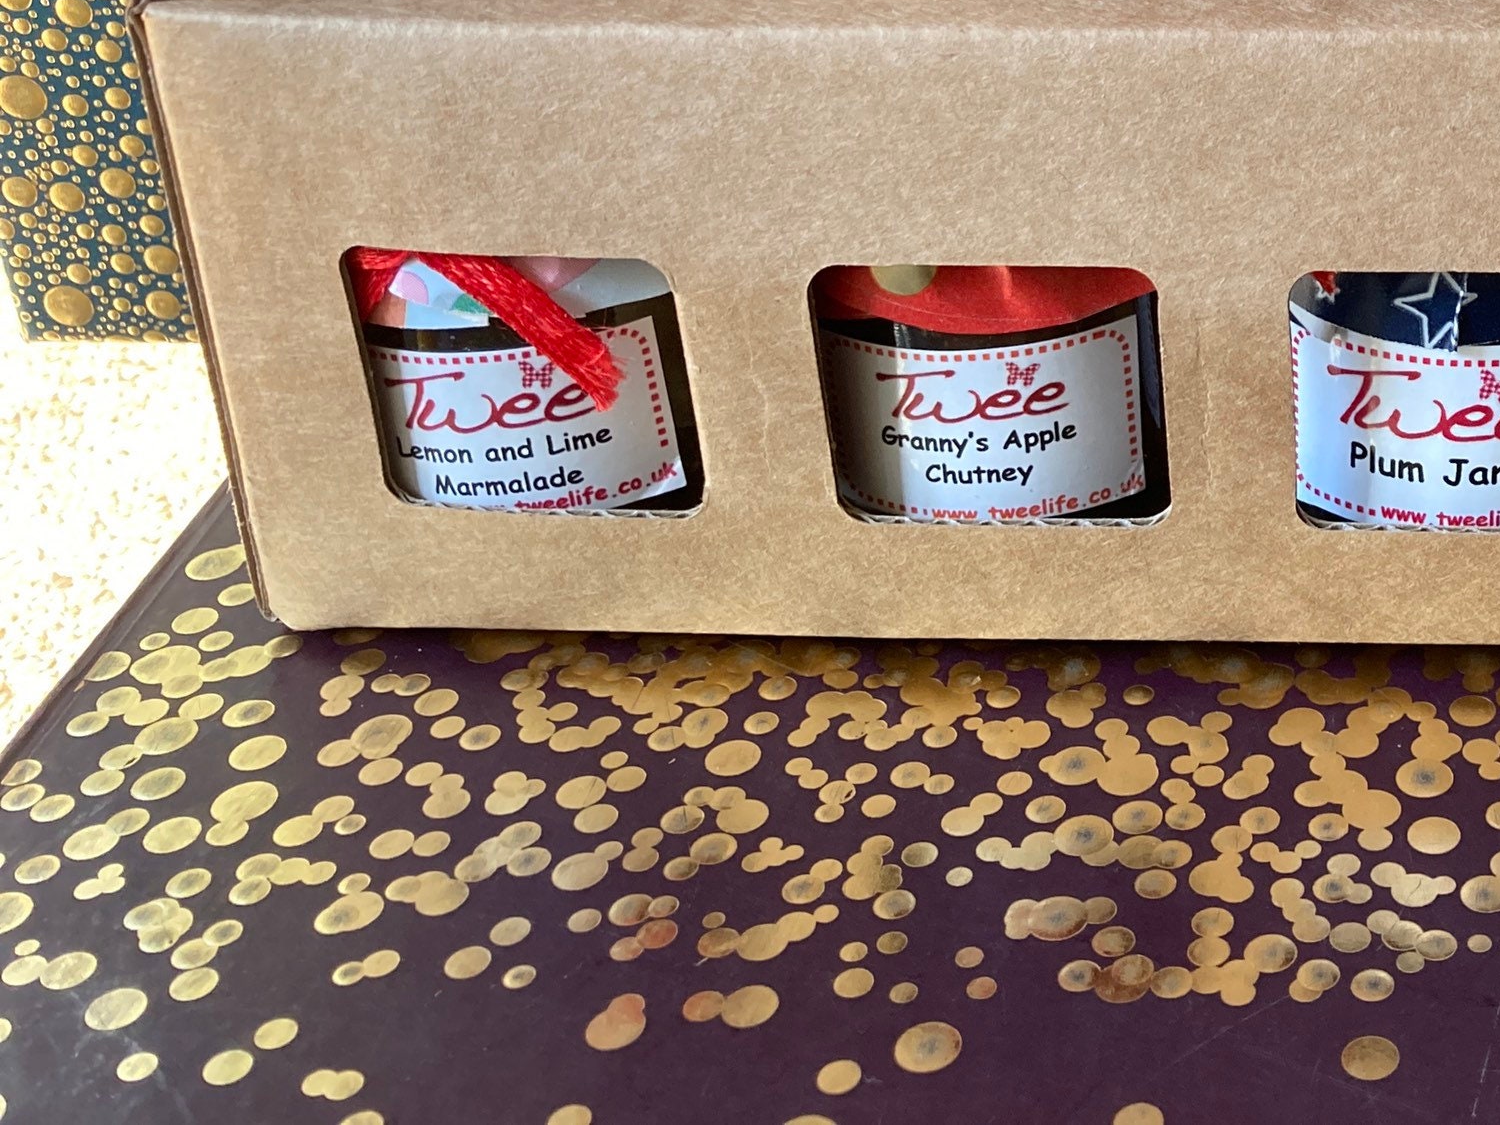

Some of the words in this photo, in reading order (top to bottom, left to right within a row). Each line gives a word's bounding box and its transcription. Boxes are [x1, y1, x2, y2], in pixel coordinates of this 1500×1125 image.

[383, 371, 597, 434] Twee
[875, 369, 1070, 424] Twee
[396, 437, 473, 465] Lemon
[485, 437, 534, 462] and
[546, 427, 613, 456] Lime
[881, 425, 989, 458] Granny's
[1003, 421, 1078, 454] Apple
[435, 466, 585, 497] Marmalade
[925, 463, 1034, 487] Chutney
[1350, 441, 1425, 484] Plum
